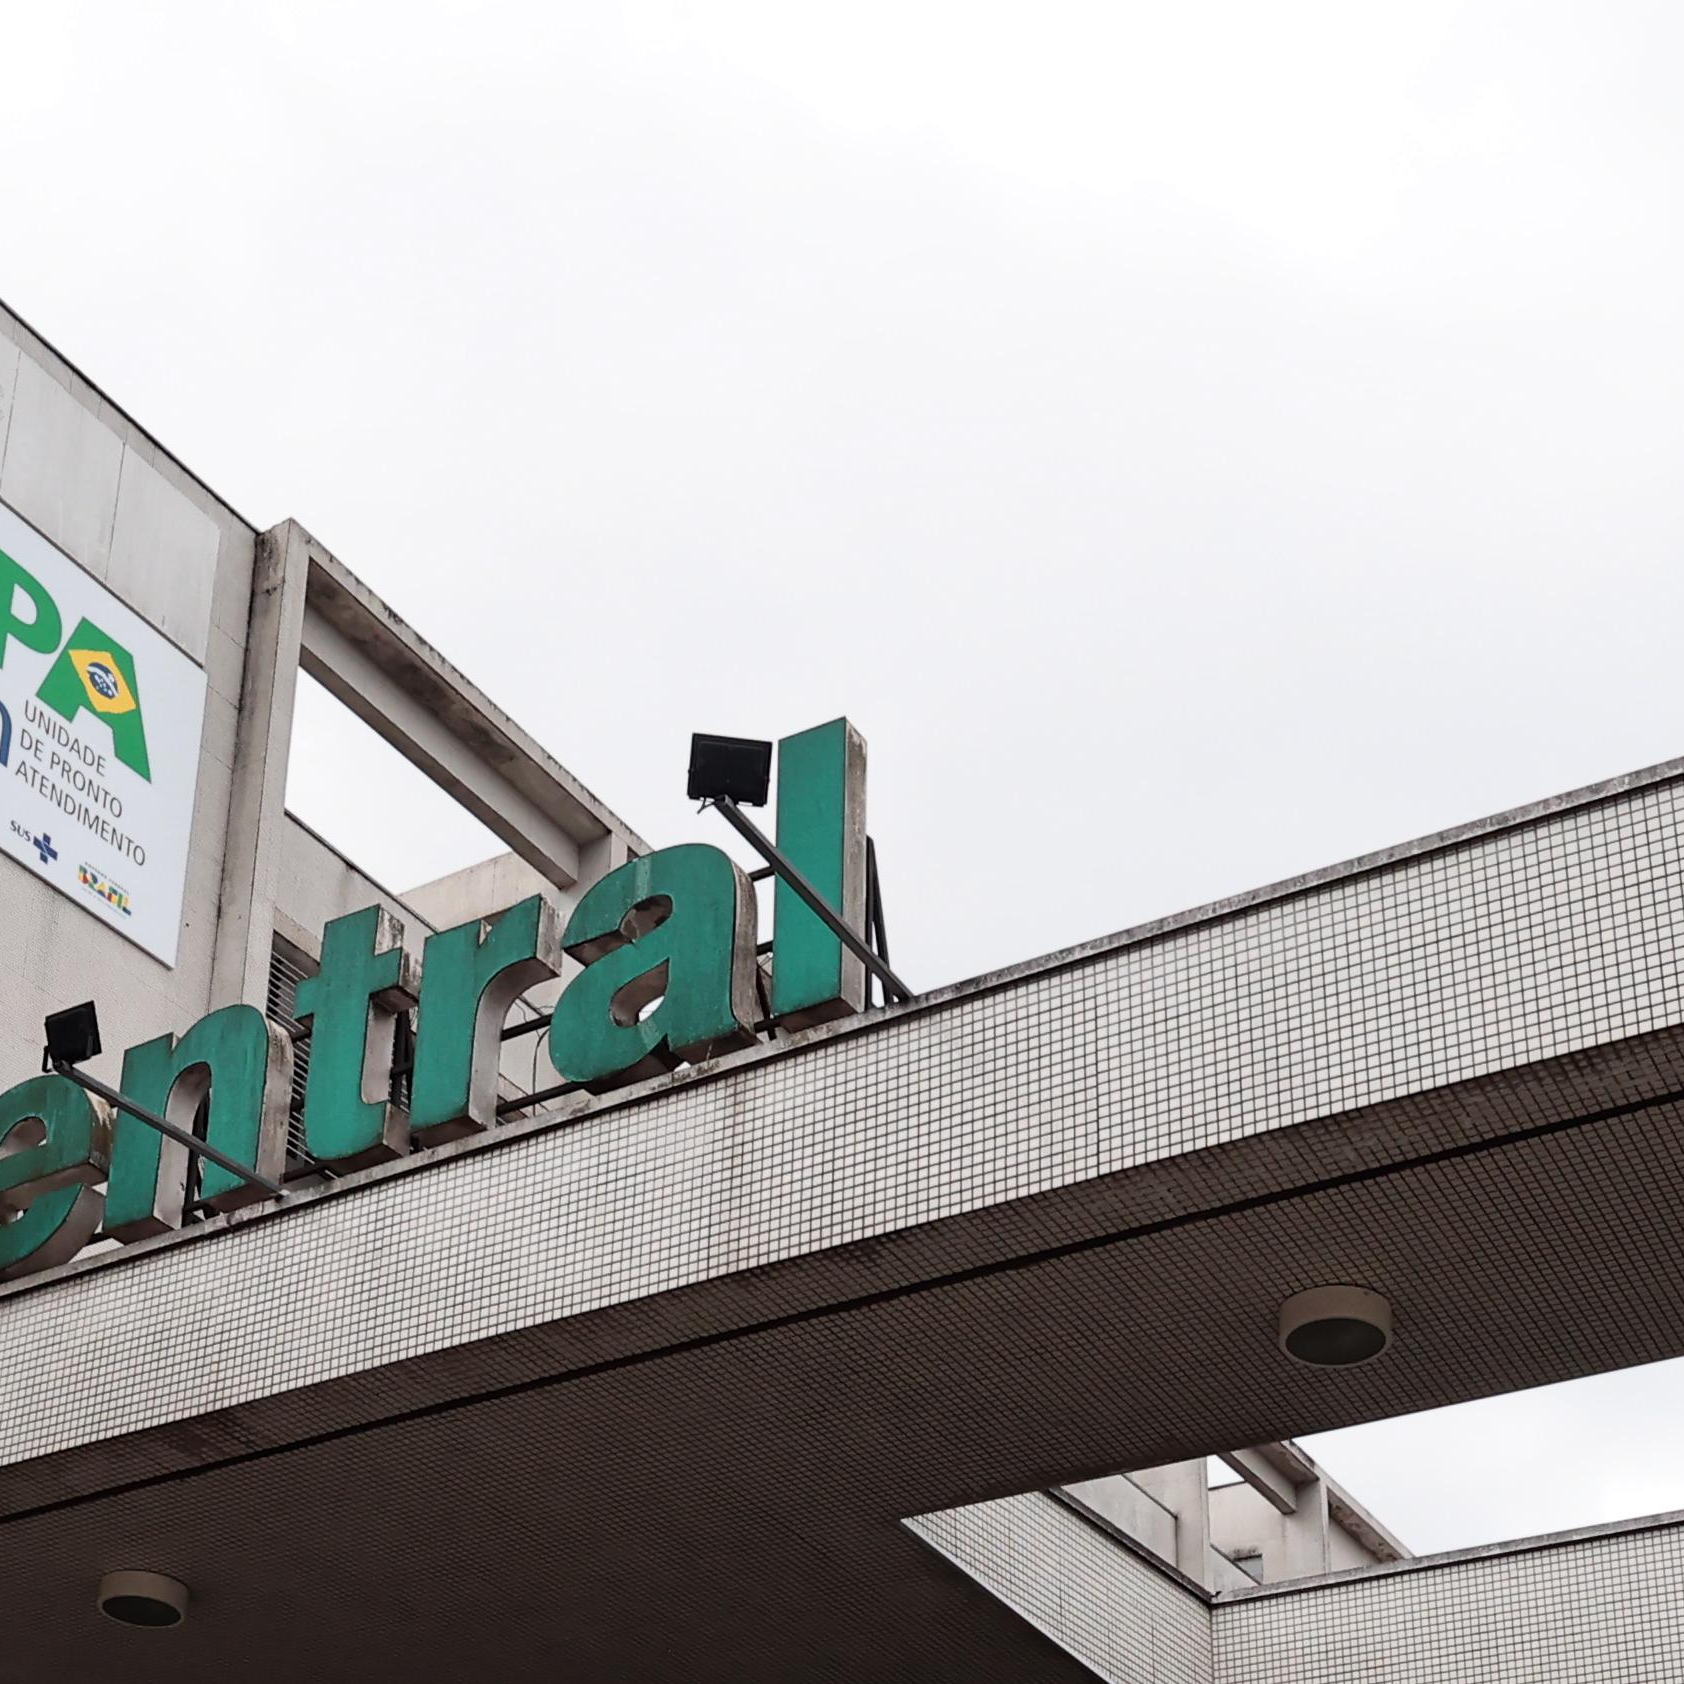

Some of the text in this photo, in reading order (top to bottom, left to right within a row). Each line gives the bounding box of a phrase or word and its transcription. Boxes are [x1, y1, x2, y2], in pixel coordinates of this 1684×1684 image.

[20, 729, 47, 762] DE
[49, 750, 123, 819] PRONTO
[24, 700, 107, 778] UNIDADE
[10, 820, 32, 842] SUS
[15, 761, 147, 867] ATENDIMENTO
[77, 864, 132, 916] BRASIL
